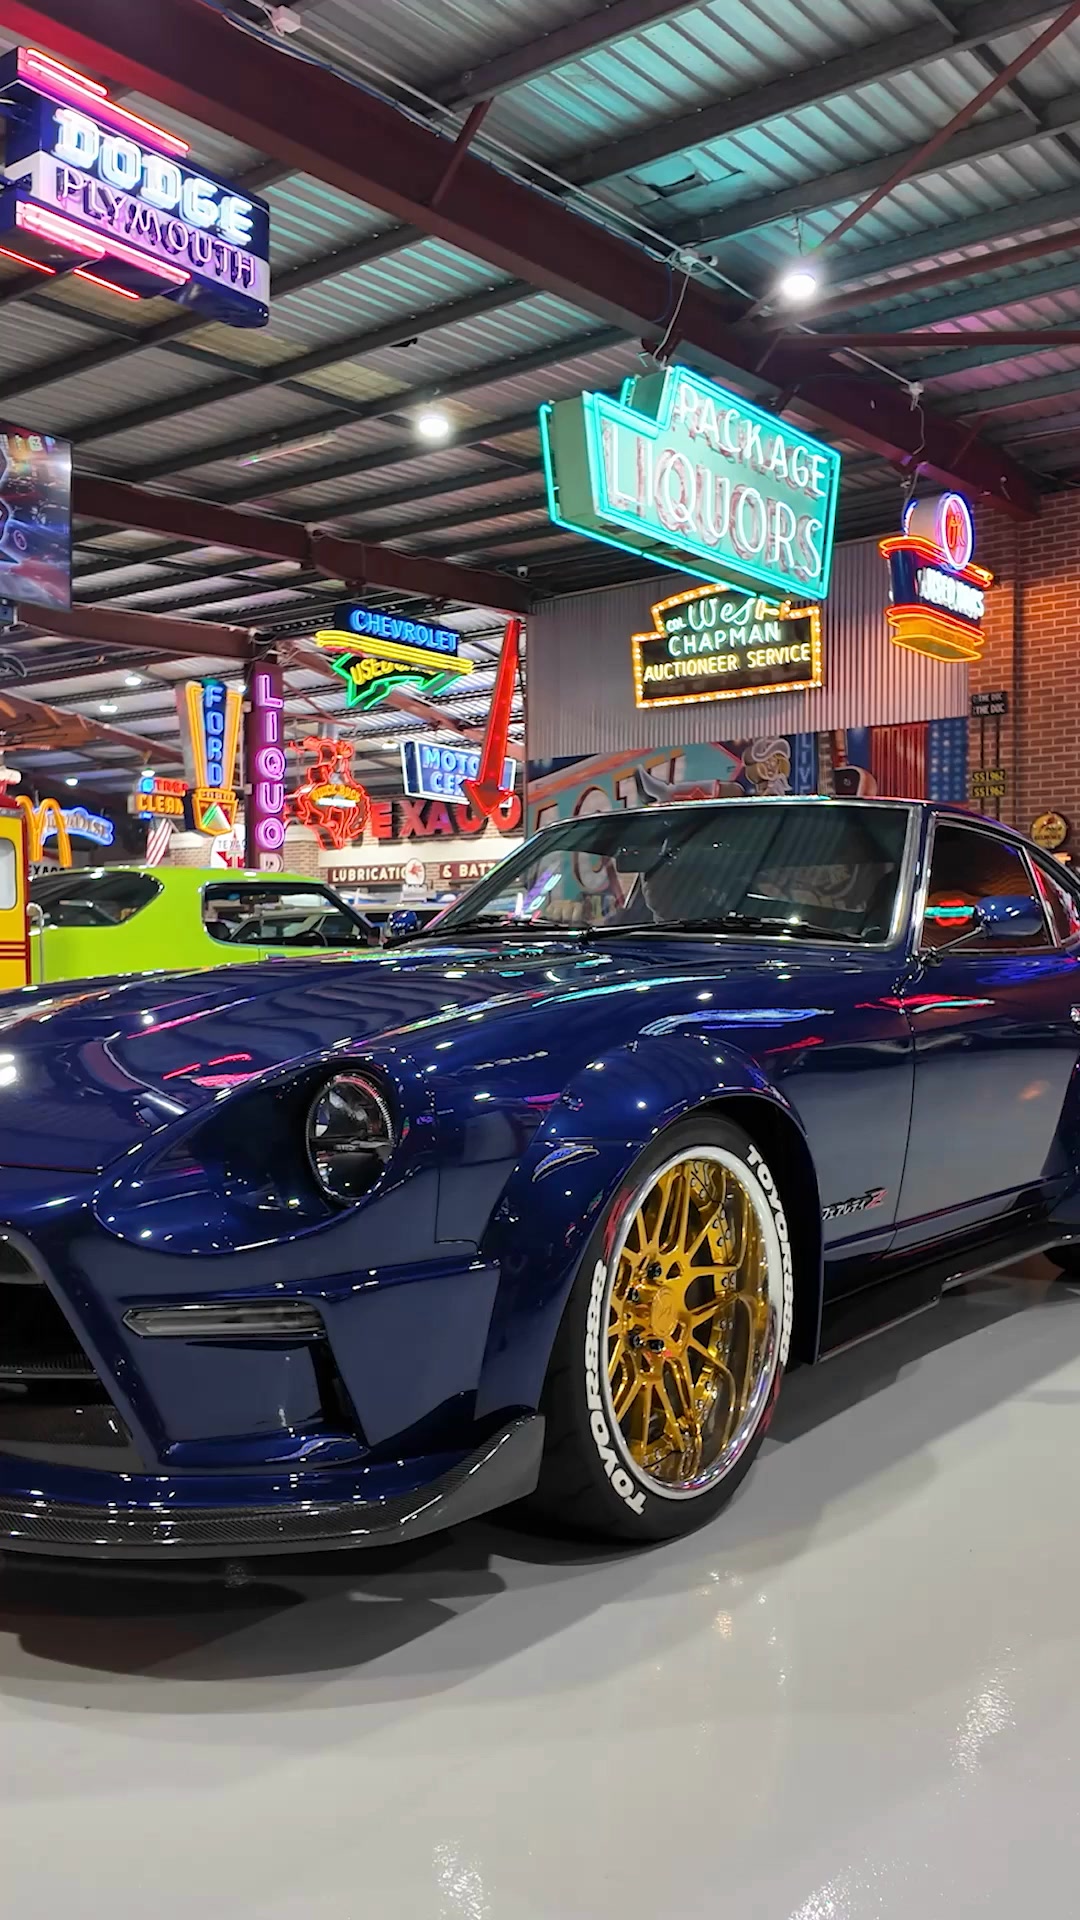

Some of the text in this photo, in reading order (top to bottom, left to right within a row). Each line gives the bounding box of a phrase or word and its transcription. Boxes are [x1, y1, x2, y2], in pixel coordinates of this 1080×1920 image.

[52, 108, 254, 245] DODGE
[56, 167, 256, 288] PLYMOUTH
[673, 383, 828, 498] PACKAGE
[602, 418, 823, 581] LIQUORS
[350, 609, 460, 652] CHEVROLET
[643, 642, 811, 683] AUCTIONEER SERVICE
[668, 621, 781, 657] CHAPMAN
[205, 685, 223, 786] FORD
[422, 746, 481, 777] MOTO
[332, 862, 497, 883] LUBRICATIO & BATT
